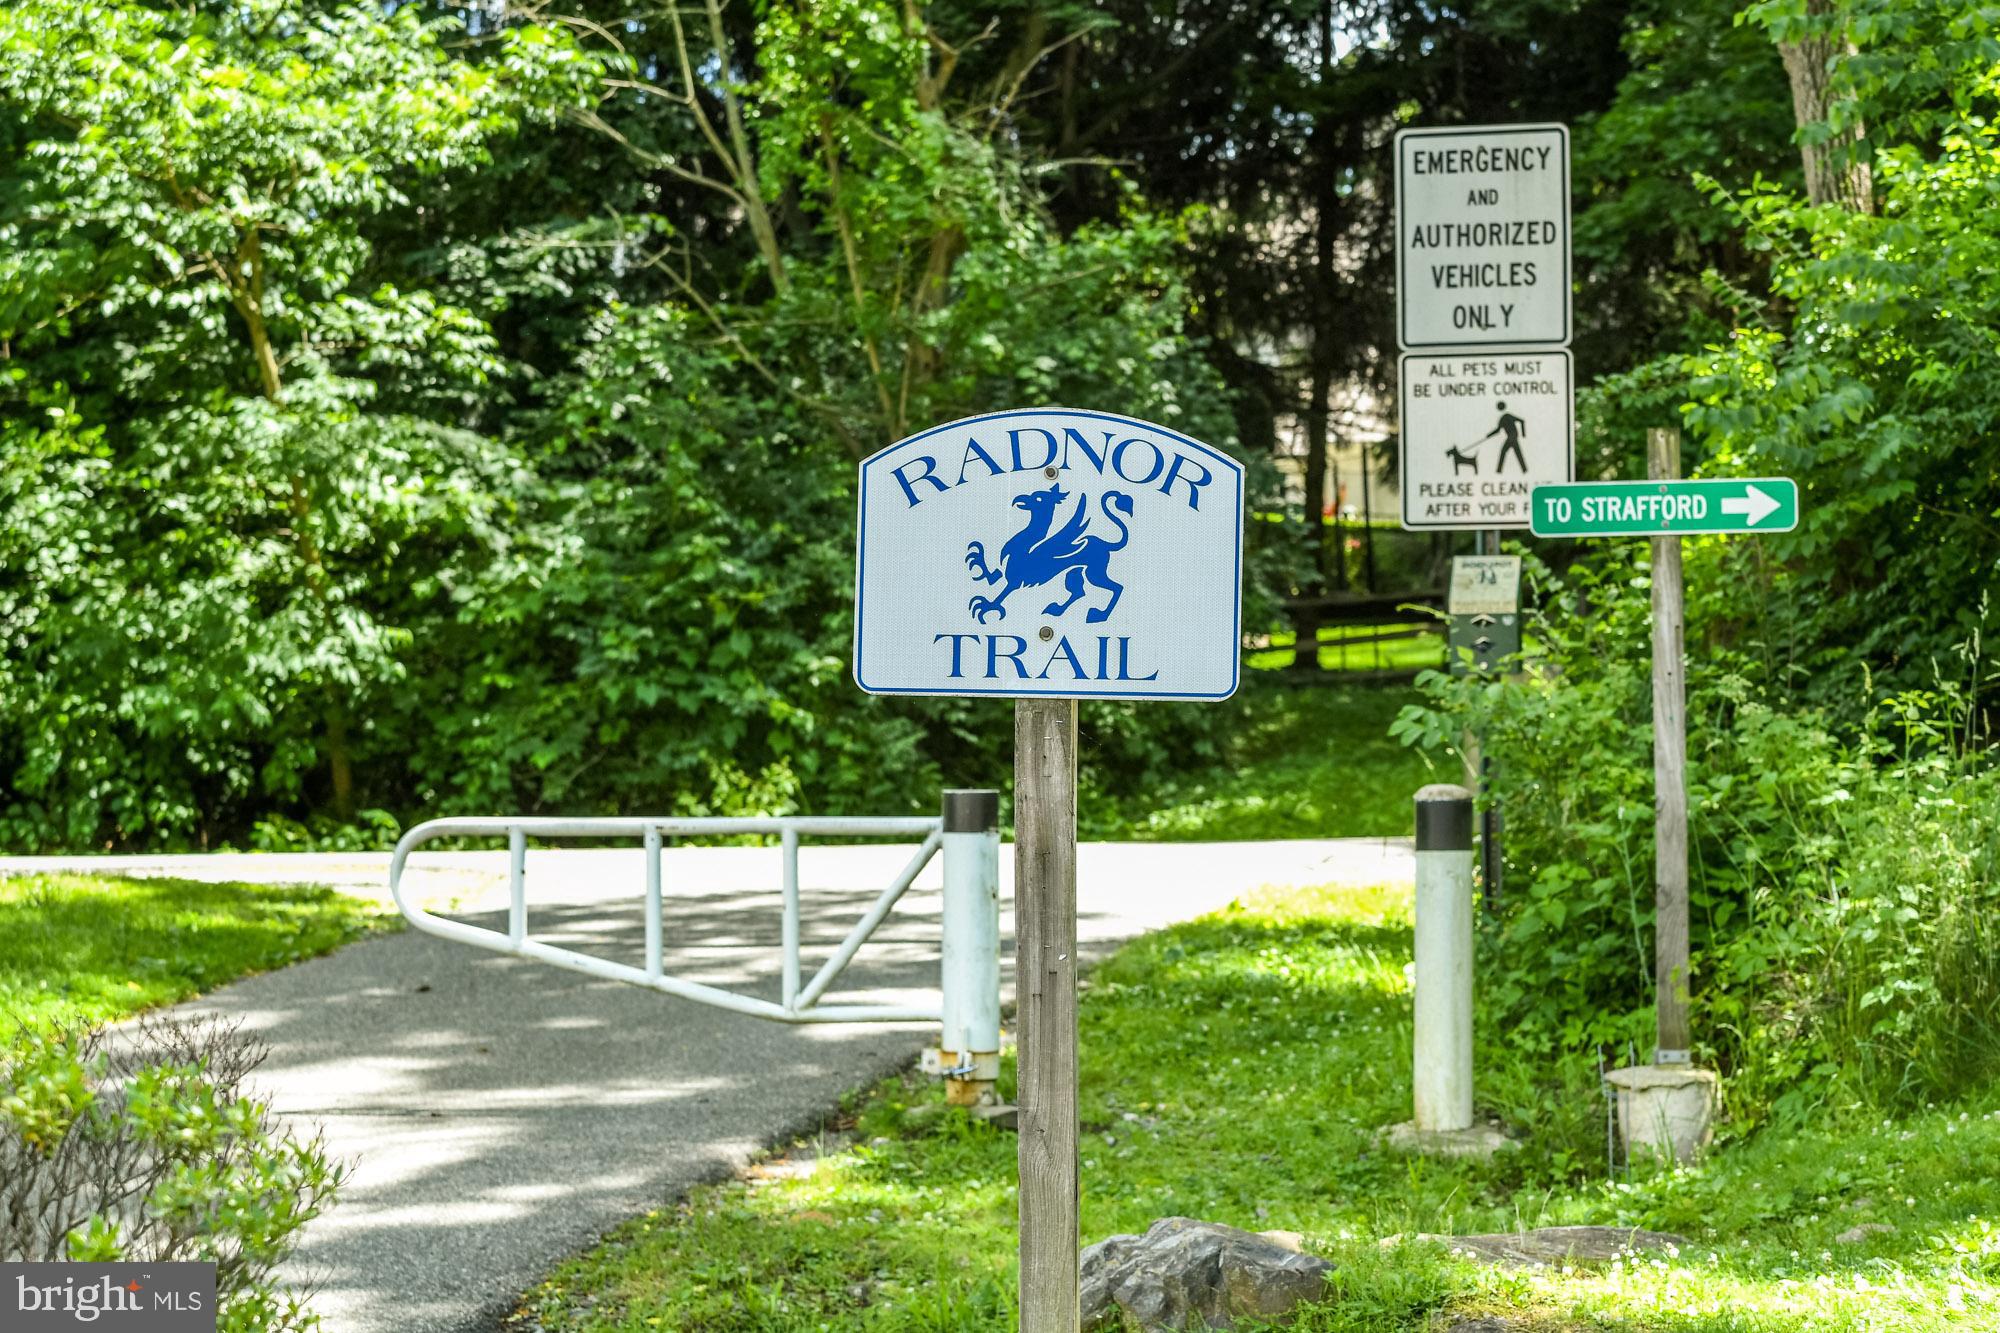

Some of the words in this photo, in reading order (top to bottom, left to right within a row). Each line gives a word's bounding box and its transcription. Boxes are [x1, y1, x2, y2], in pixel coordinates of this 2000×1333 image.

[1413, 147, 1551, 174] EMERGENCY
[1467, 189, 1499, 205] AND
[1411, 221, 1556, 248] AUTHORIZED
[1431, 263, 1537, 288] VEHICLES
[1453, 304, 1514, 329] ONLY
[1429, 364, 1455, 377] ALL
[1463, 362, 1498, 376] PETS
[1505, 361, 1542, 375] MUST
[1413, 384, 1431, 397] BE
[1439, 382, 1486, 397] UNDER
[1493, 381, 1558, 396] CONTROL
[890, 427, 1213, 512] RADNOR
[1419, 482, 1473, 497] PLEASE
[1481, 481, 1528, 496] CLEAN
[1426, 502, 1471, 517] AFTER
[1478, 501, 1516, 516] YOUR
[1544, 497, 1571, 523] TO
[1581, 495, 1707, 522] STRAFFORD
[933, 633, 1159, 681] TRAIL
